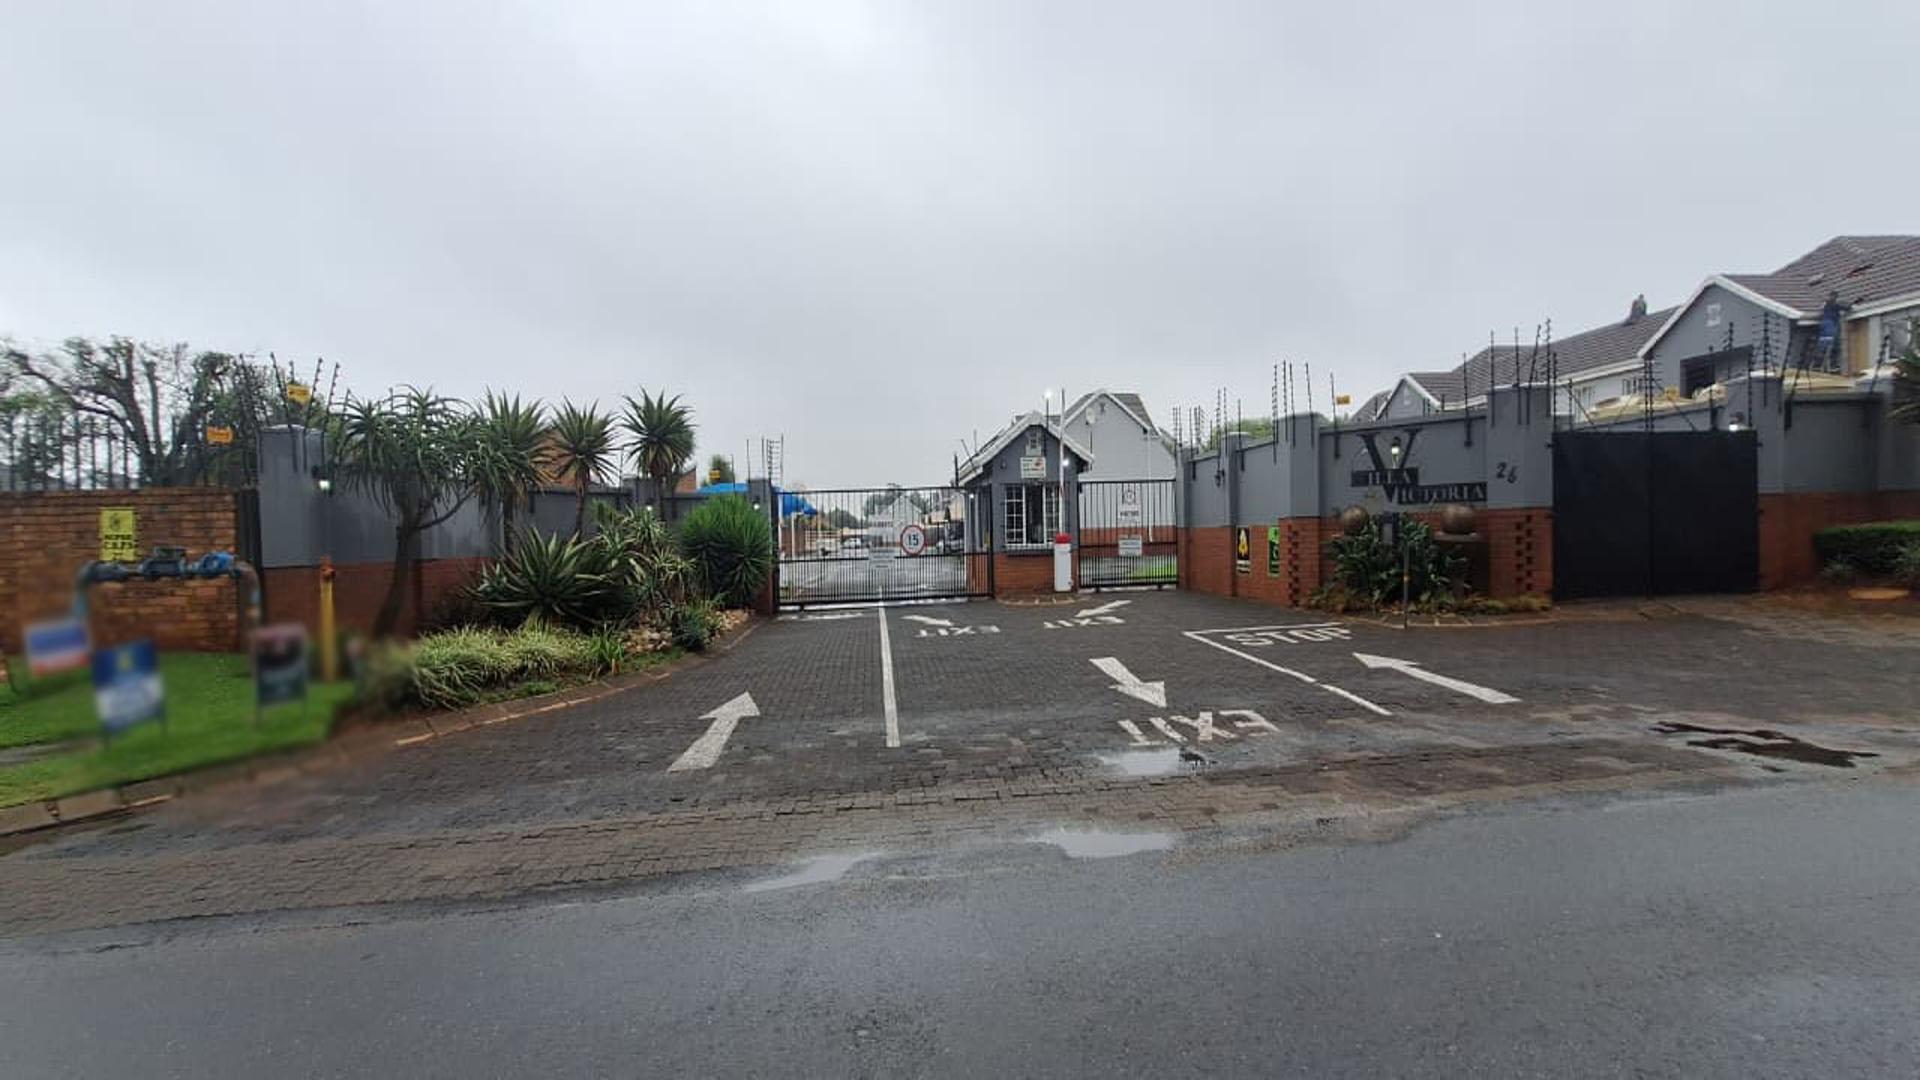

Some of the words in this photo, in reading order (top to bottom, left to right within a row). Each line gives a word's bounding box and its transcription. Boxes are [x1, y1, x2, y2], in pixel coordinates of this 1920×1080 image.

[1496, 461, 1518, 484] 26
[908, 533, 919, 546] 15
[1224, 627, 1353, 646] STOP
[1117, 709, 1283, 747] EXIT
